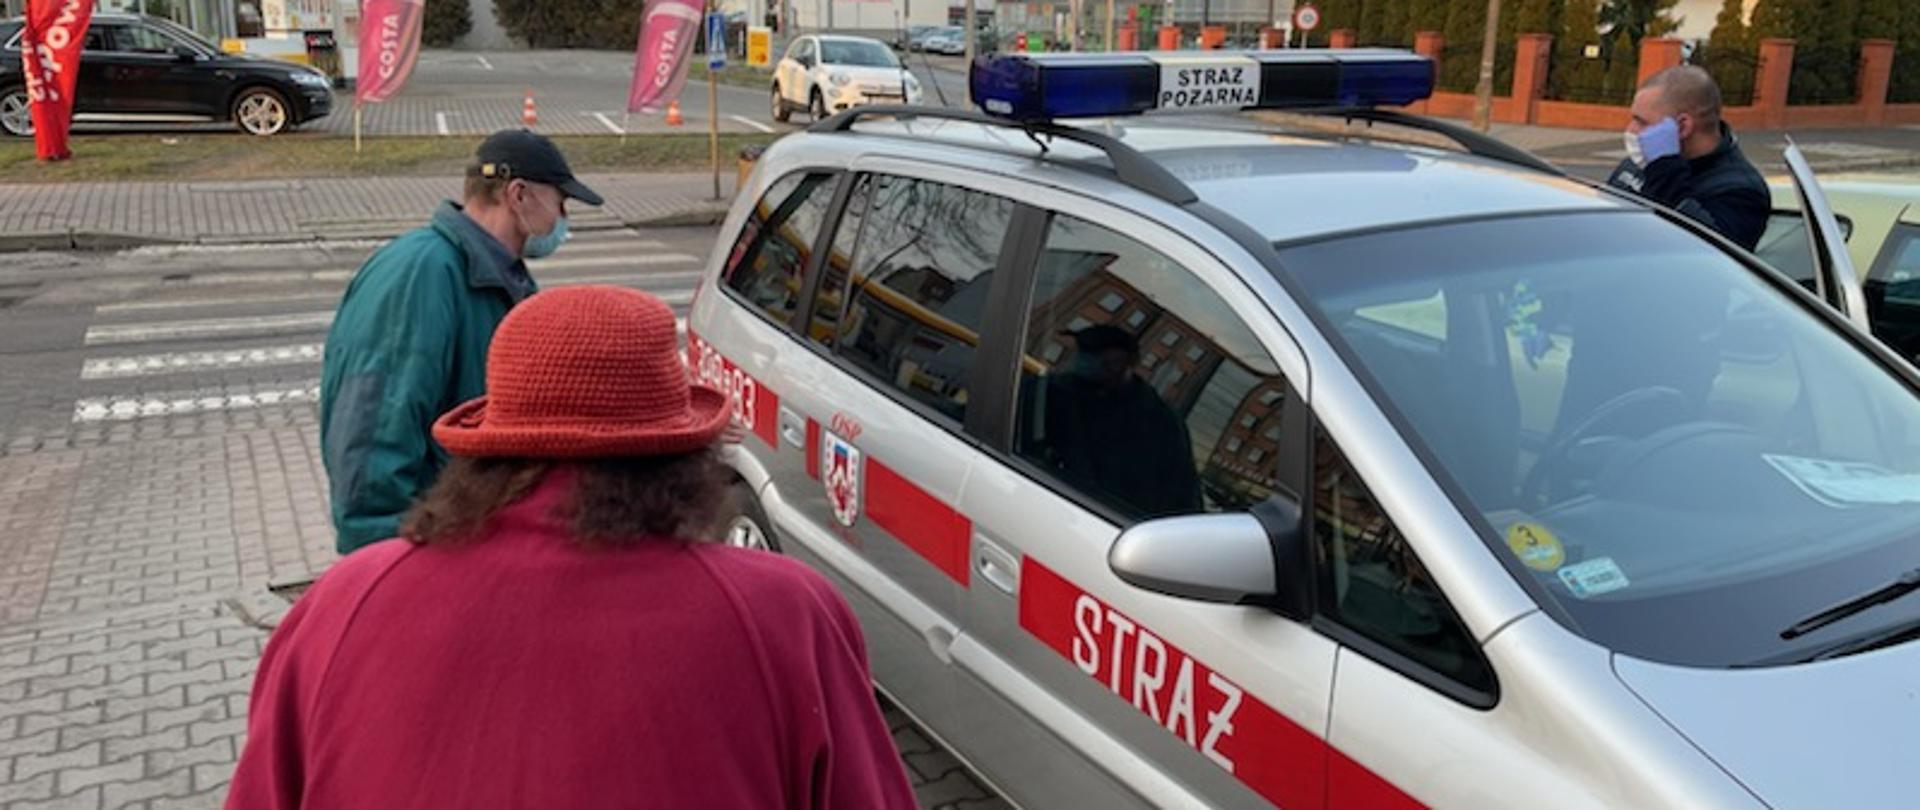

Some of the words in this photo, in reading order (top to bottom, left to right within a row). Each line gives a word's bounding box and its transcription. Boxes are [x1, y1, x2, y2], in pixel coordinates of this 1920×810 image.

[379, 14, 400, 79] COSTA
[654, 29, 679, 88] COSTA
[1516, 525, 1538, 547] 3
